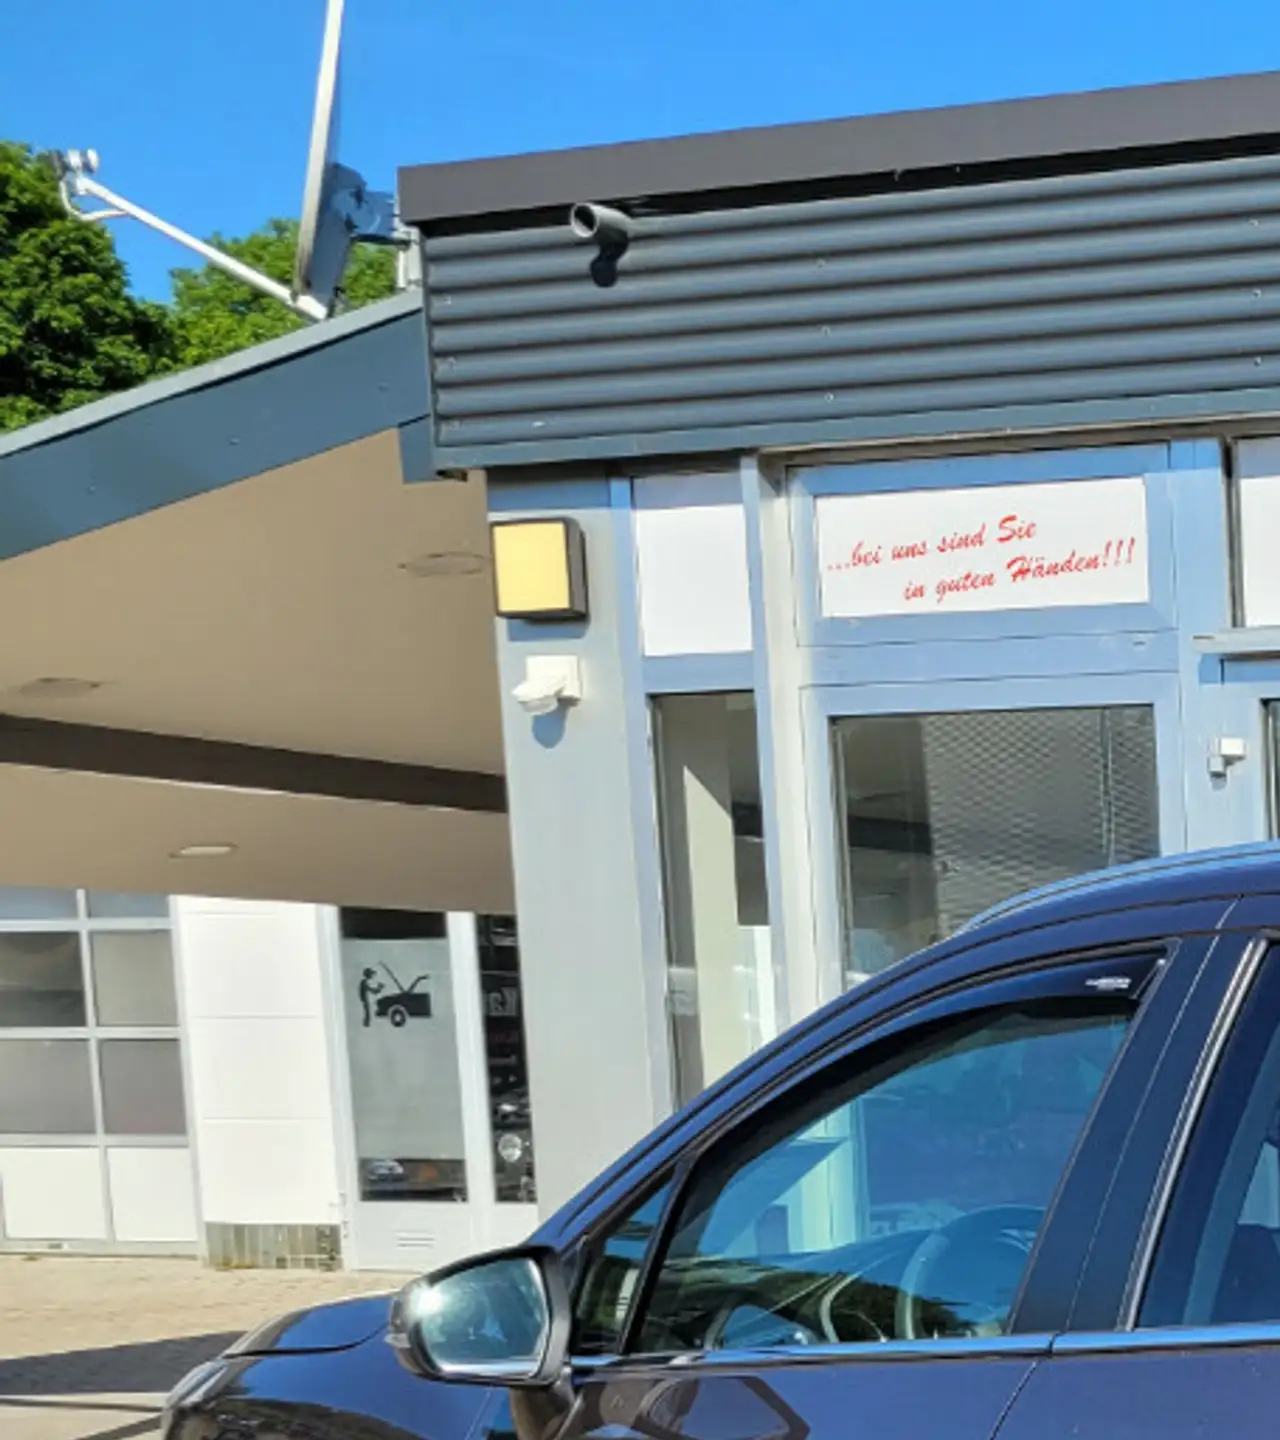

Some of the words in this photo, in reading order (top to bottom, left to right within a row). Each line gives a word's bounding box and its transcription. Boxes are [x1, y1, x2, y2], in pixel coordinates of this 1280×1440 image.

[890, 540, 928, 561] uns
[936, 523, 987, 554] sind
[995, 514, 1037, 544] Sie
[903, 579, 926, 601] in
[934, 568, 996, 604] guten
[1005, 536, 1137, 583] Händen!!!
